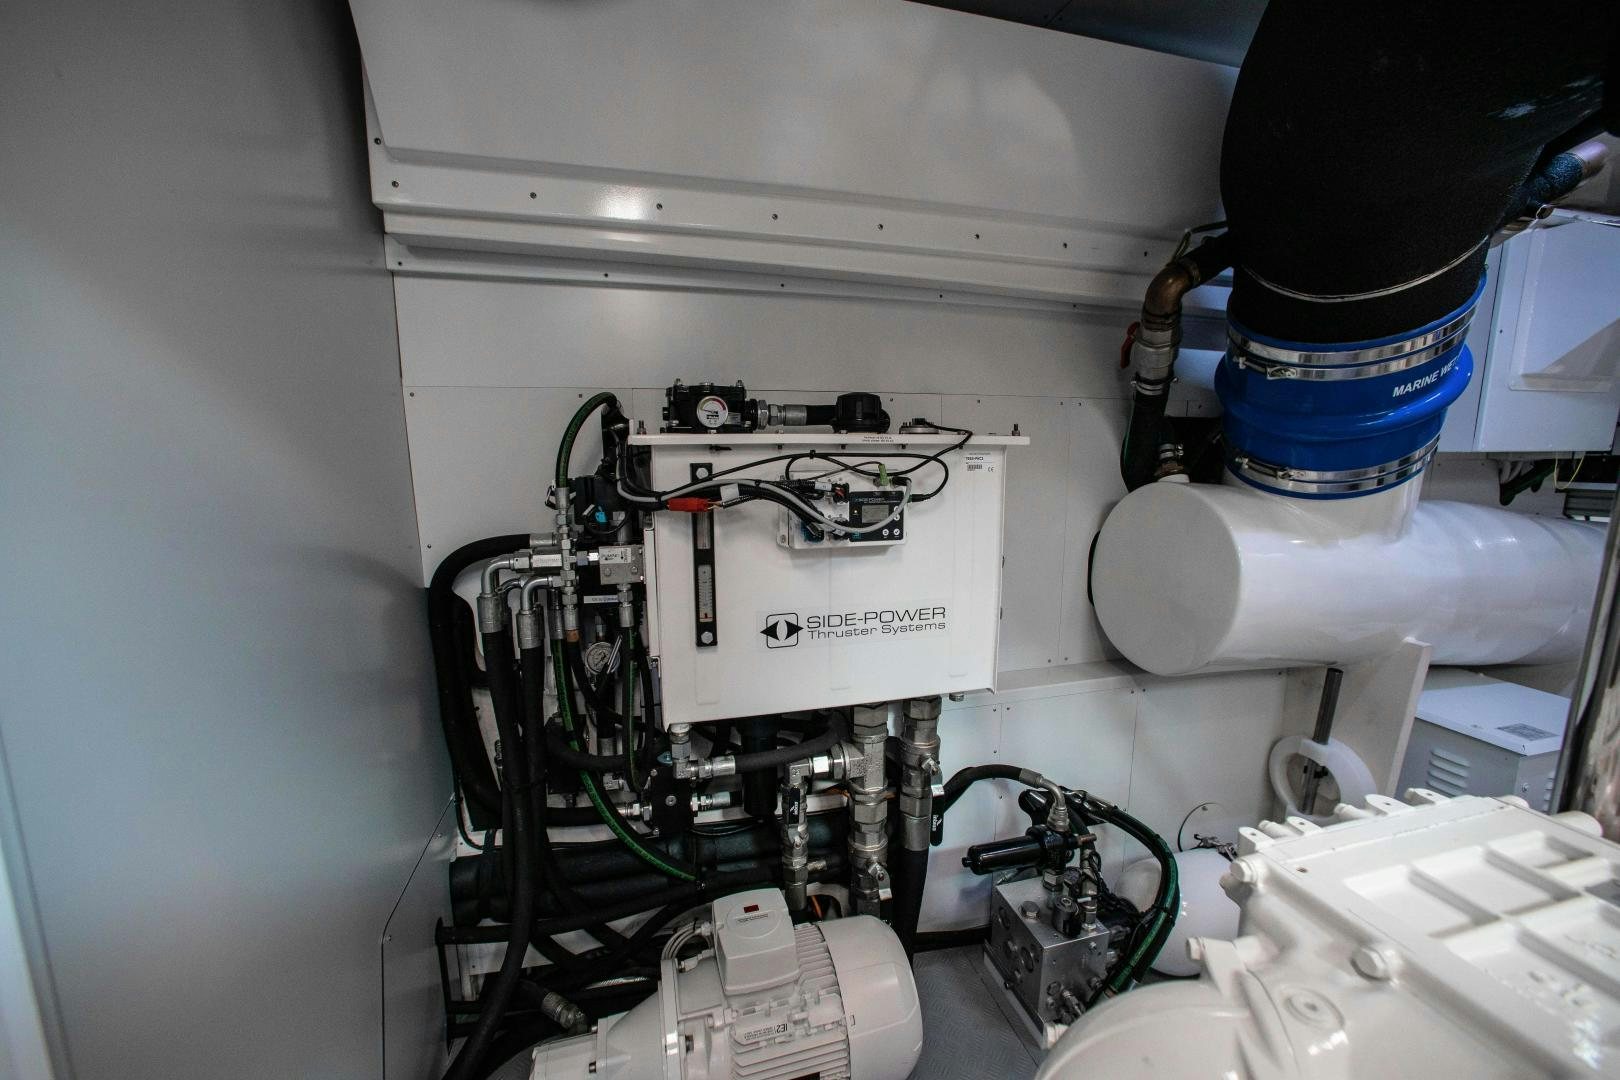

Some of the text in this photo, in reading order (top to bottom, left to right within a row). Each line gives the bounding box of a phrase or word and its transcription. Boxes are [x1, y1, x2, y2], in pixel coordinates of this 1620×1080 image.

[1392, 370, 1440, 397] MARINE
[807, 607, 946, 629] SIDE-POWER
[808, 622, 946, 640] Thruster Systems
